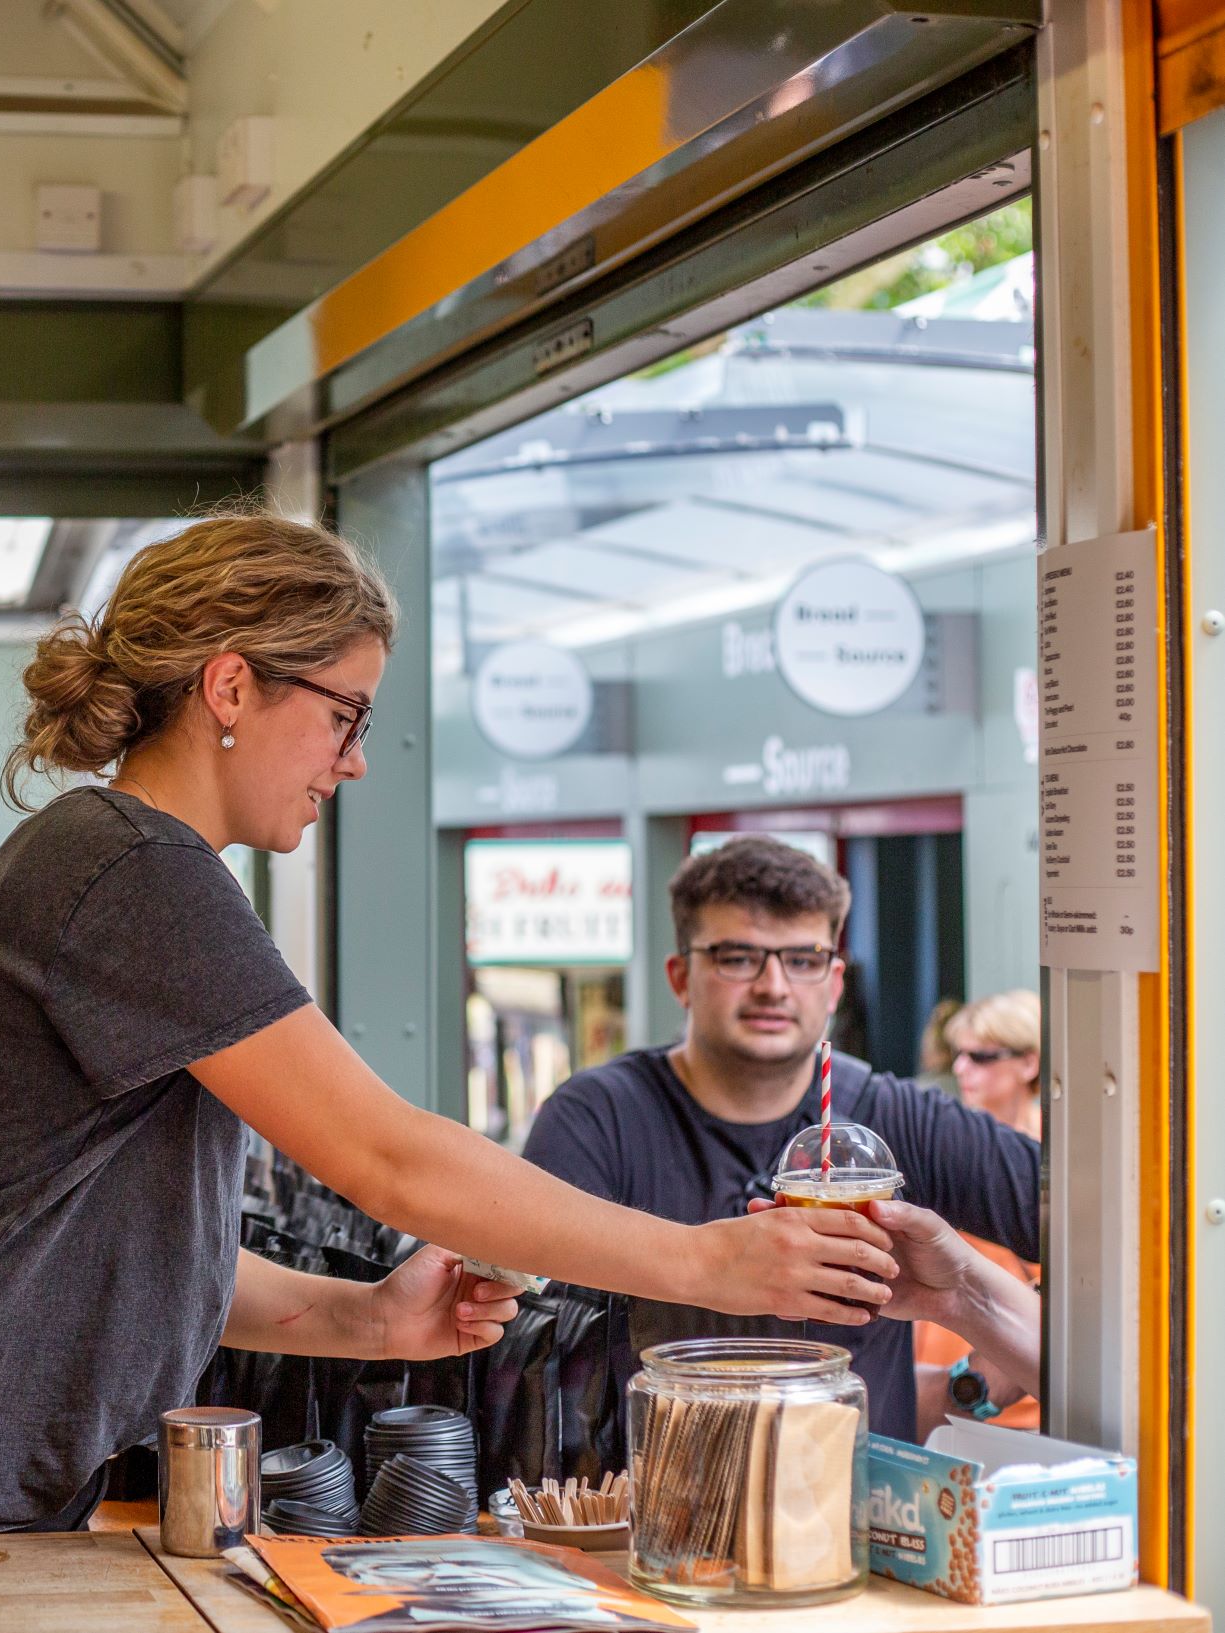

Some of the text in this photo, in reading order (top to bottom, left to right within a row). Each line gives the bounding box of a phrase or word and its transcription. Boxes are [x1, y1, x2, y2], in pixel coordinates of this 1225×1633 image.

[1115, 570, 1135, 581] £2.40
[1115, 584, 1135, 595] £2.40
[796, 603, 858, 623] Bread
[836, 644, 907, 664] Source
[762, 735, 850, 796] Source
[1115, 783, 1135, 793] £2.50
[1115, 797, 1135, 807] £2.50
[1115, 811, 1135, 821] £2.50
[1115, 826, 1135, 835] £2.50
[1115, 840, 1135, 850] £2.50
[1115, 854, 1135, 864] £2.50
[1115, 868, 1135, 878] £2.50
[1120, 925, 1134, 937] 30p
[899, 1536, 926, 1551] BLISS
